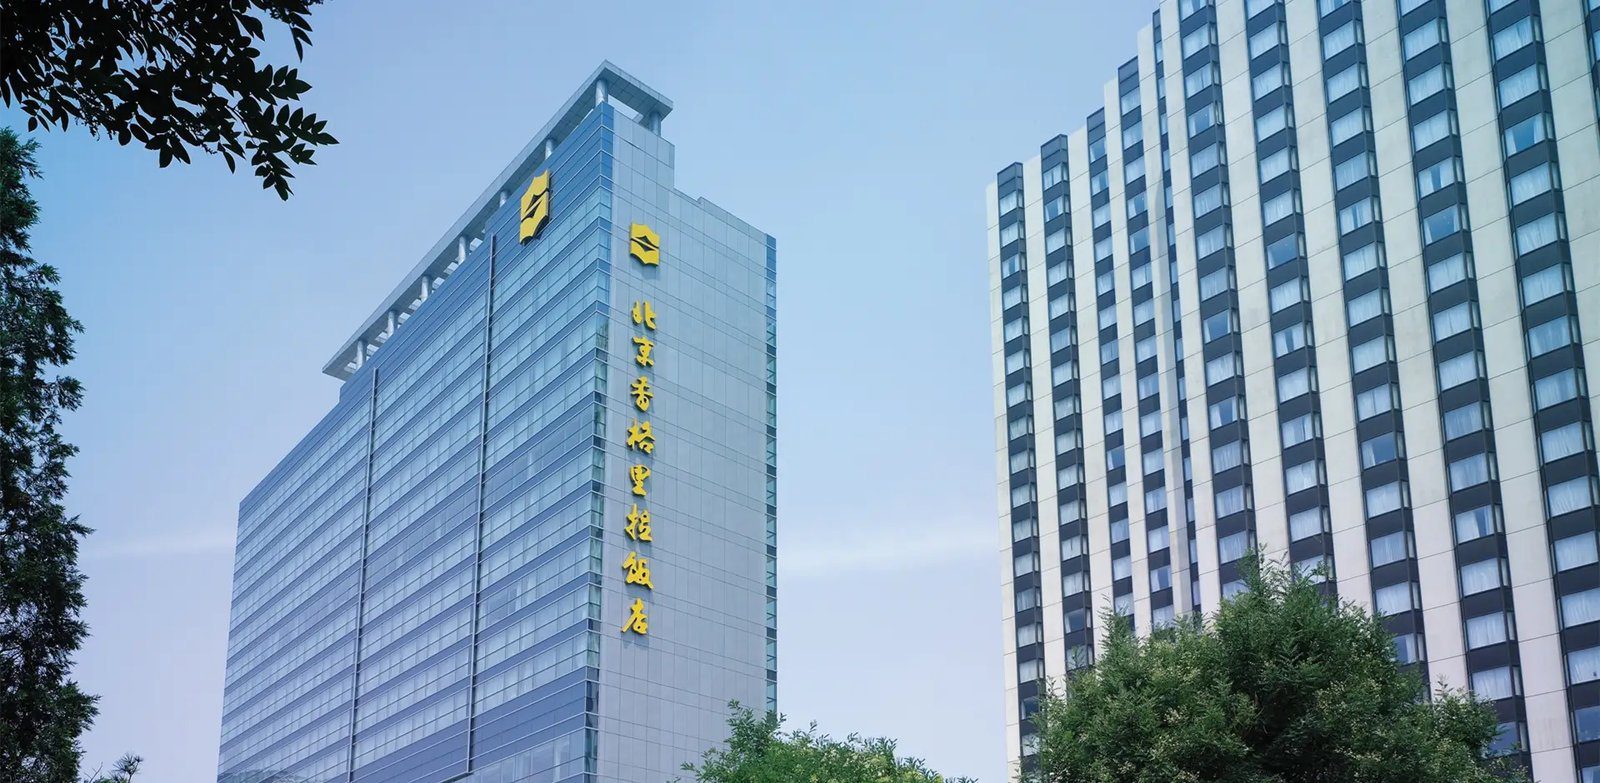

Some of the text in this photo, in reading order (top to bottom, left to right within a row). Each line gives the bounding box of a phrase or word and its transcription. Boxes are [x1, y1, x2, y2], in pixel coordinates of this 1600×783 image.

[620, 300, 657, 636] 北京香格里拉饭店
